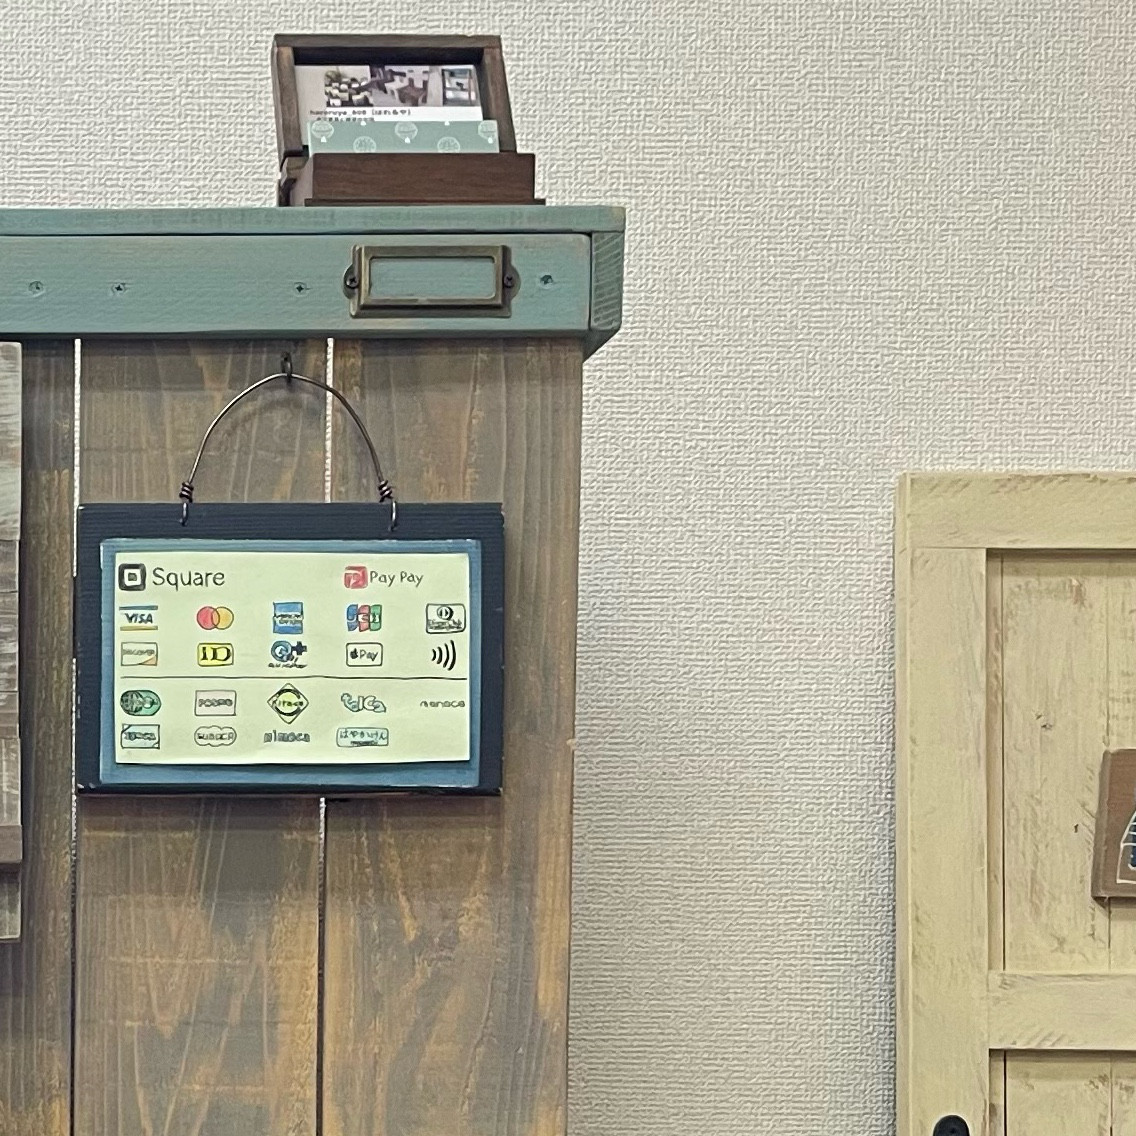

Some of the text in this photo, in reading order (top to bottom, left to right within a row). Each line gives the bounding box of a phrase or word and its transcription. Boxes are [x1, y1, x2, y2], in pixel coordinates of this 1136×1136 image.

[152, 567, 226, 592] Square
[370, 570, 424, 588] Pay Pay
[124, 612, 154, 625] VISA
